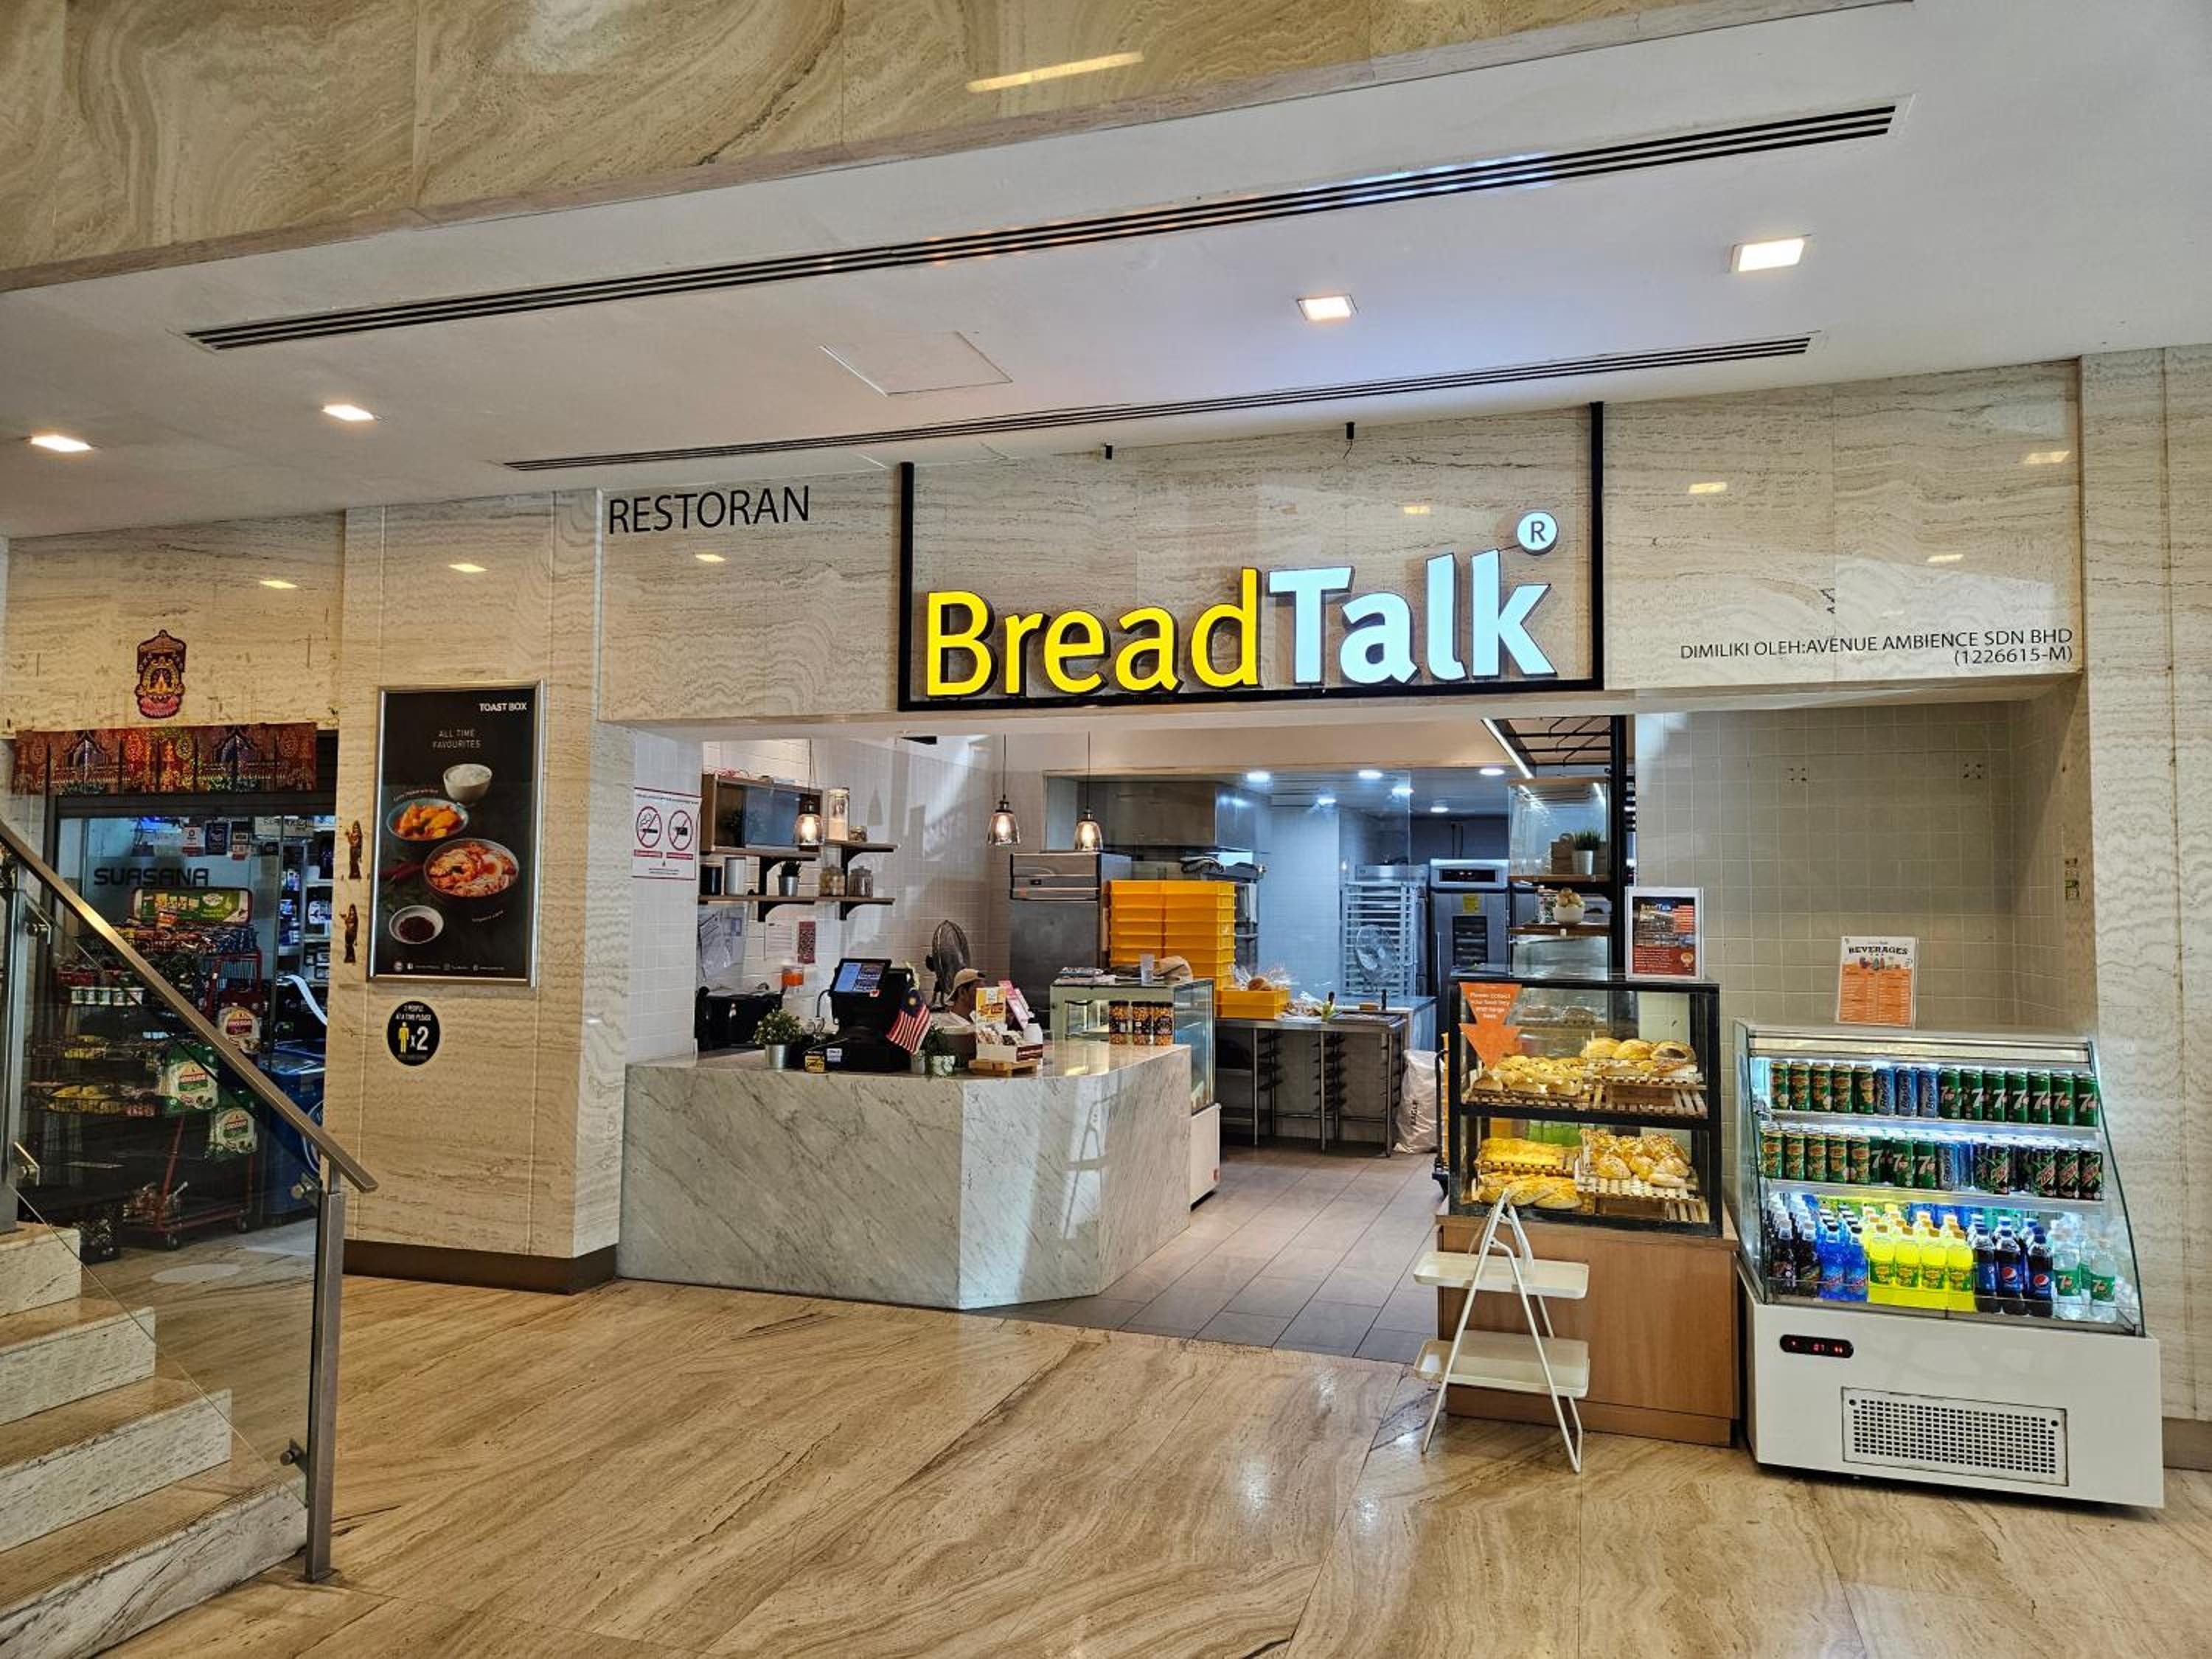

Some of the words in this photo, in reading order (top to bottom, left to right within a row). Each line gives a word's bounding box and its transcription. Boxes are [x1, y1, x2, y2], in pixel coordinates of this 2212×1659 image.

[609, 485, 809, 534] RESTORAN
[926, 549, 1557, 697] BreadTalk
[1680, 642, 1749, 658] DIMILIKI
[1882, 632, 1978, 650] AMBIENCE
[1984, 630, 2024, 646] SDN
[2031, 628, 2073, 644] BHD
[1955, 646, 2073, 667] (1226615-M)
[479, 703, 508, 712] TOAST
[509, 702, 527, 711] BOX
[439, 729, 453, 738] ALL
[456, 728, 476, 737] TIME
[432, 740, 482, 749] FAVOURITES
[94, 868, 209, 886] SUASANA
[1848, 946, 1909, 955] BEVERAGES
